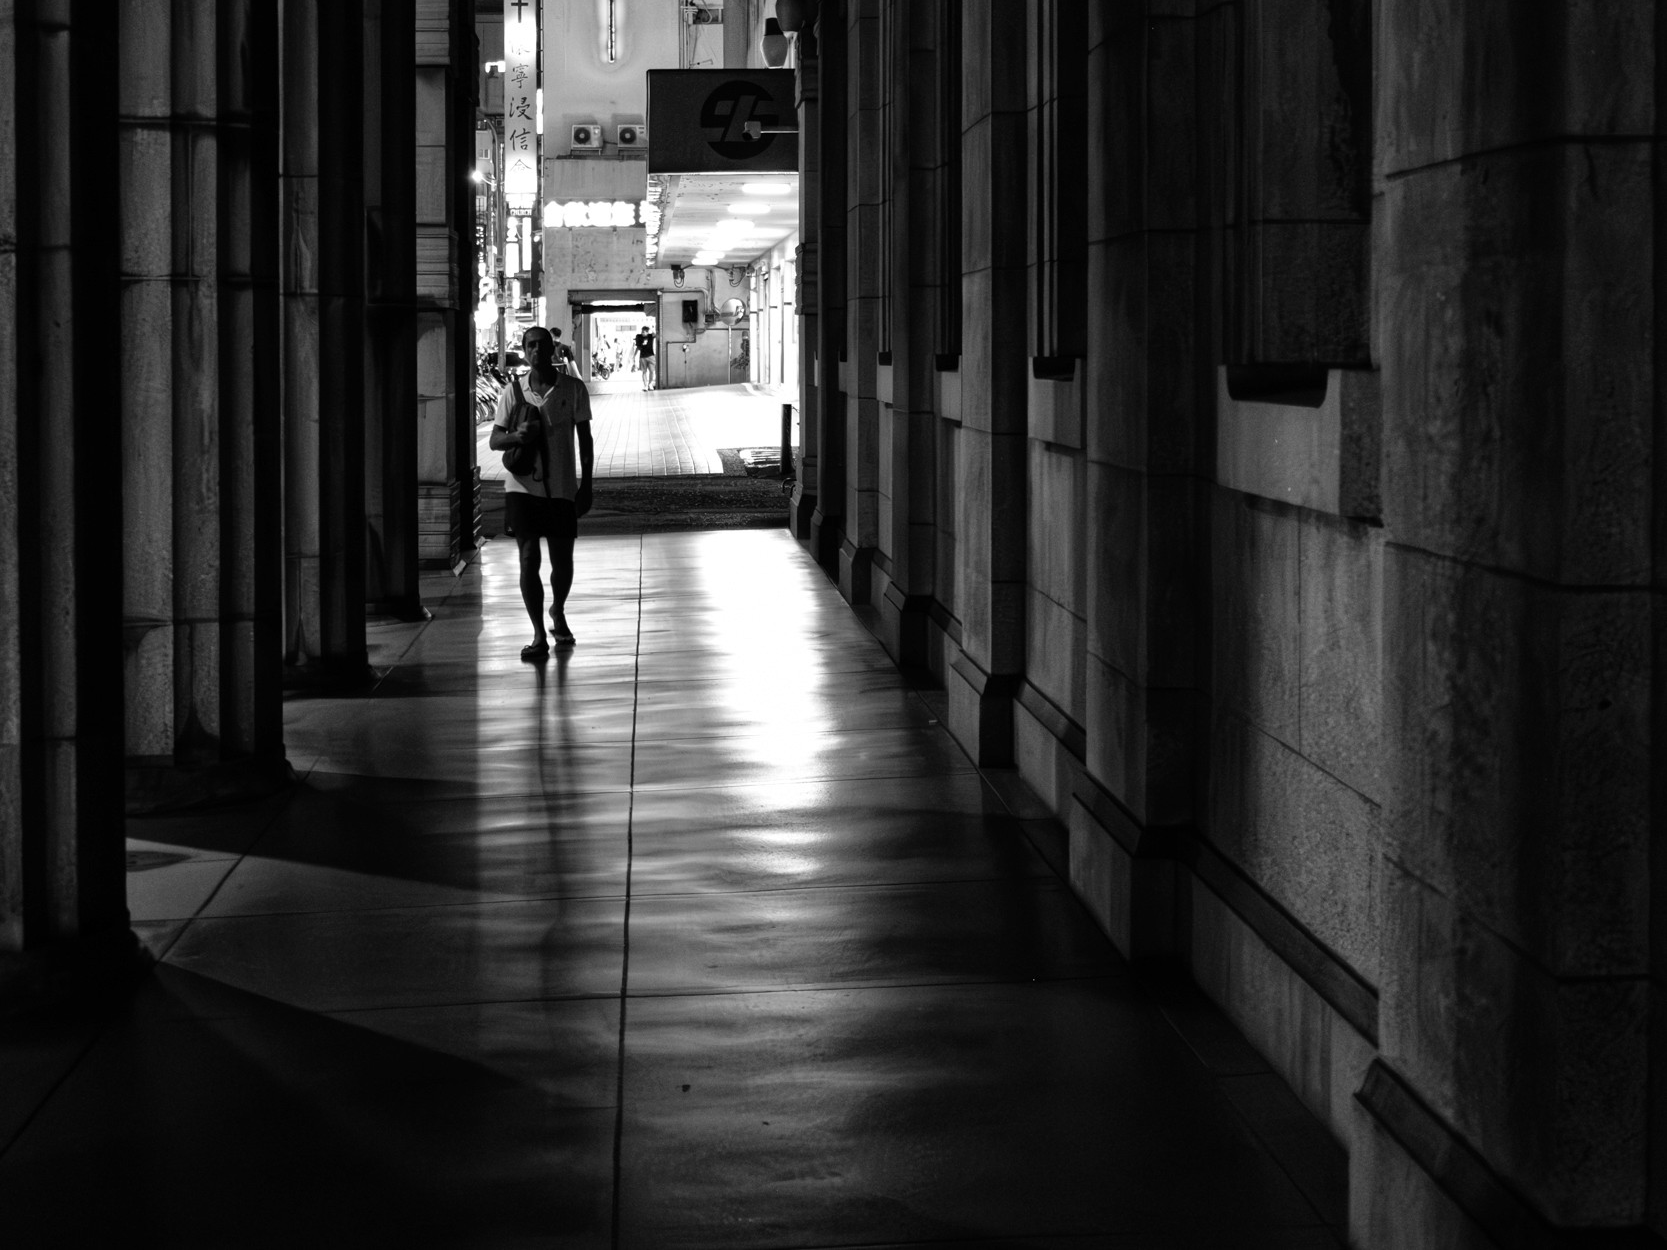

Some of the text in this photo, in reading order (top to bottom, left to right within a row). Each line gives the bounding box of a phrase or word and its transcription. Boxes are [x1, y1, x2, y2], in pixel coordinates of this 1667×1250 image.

[509, 43, 533, 171] 寧浸信
[510, 208, 531, 216] CHURCH
